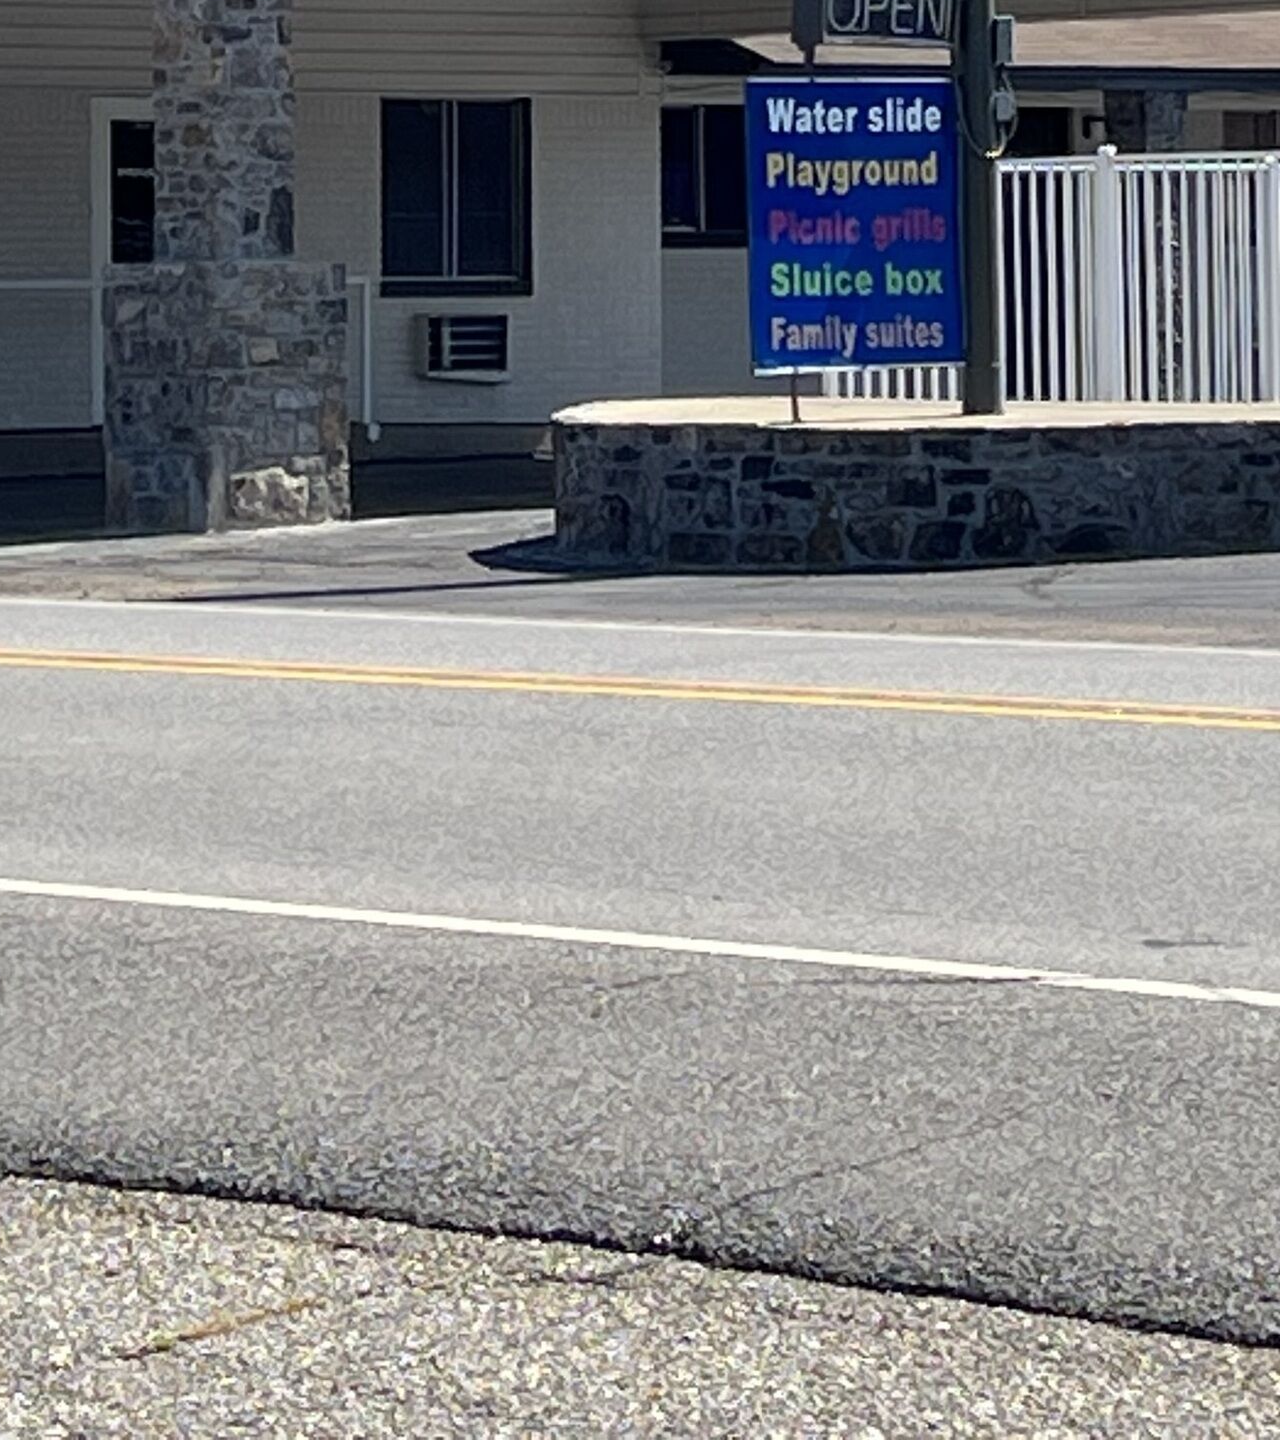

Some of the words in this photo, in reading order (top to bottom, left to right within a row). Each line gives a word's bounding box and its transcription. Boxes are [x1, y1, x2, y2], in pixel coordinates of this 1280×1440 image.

[767, 97, 858, 133] Water
[867, 97, 941, 133] slide
[767, 151, 938, 195] Playground
[771, 210, 860, 245] Picnic
[873, 208, 946, 251] grills
[771, 262, 873, 296] Sluice
[885, 262, 943, 295] box
[771, 315, 857, 358] Family
[866, 314, 944, 349] suites
